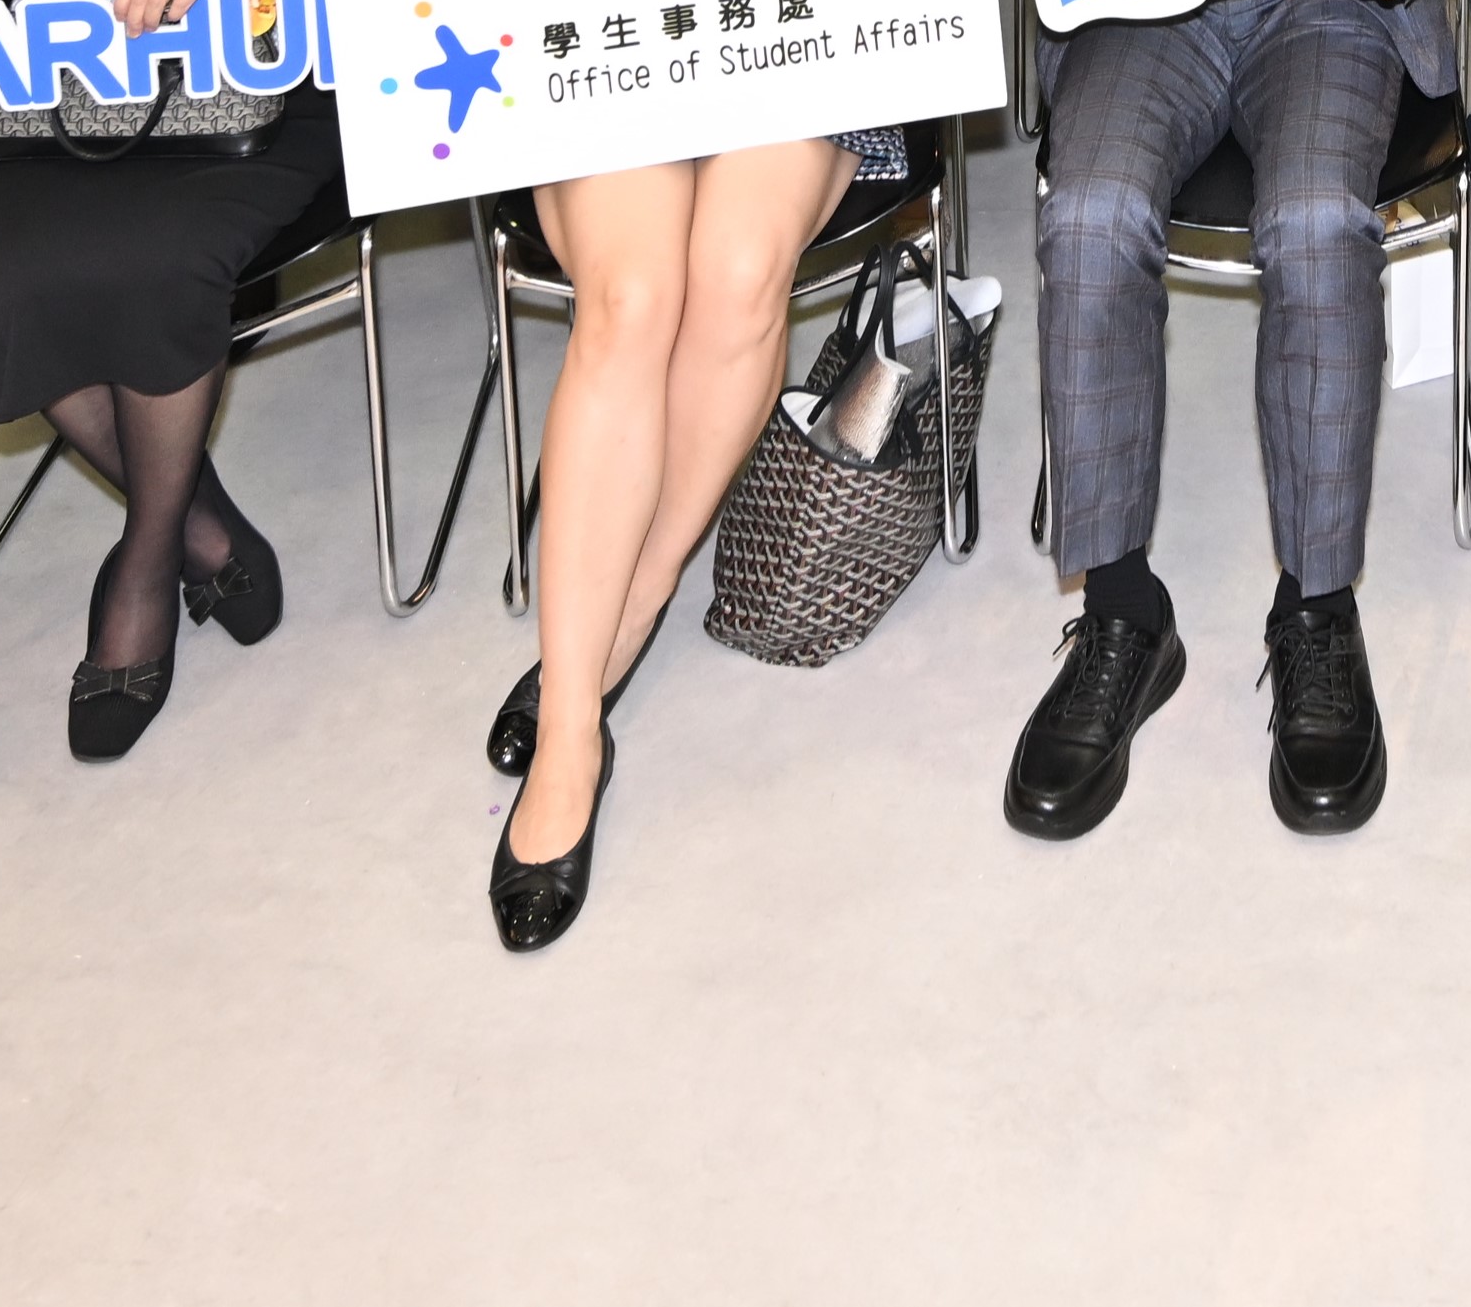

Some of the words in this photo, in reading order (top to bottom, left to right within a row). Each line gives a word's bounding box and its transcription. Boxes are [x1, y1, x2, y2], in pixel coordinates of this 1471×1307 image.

[548, 60, 652, 104] Office
[669, 51, 700, 84] of
[719, 36, 837, 76] Student
[853, 10, 965, 55] Affairs
